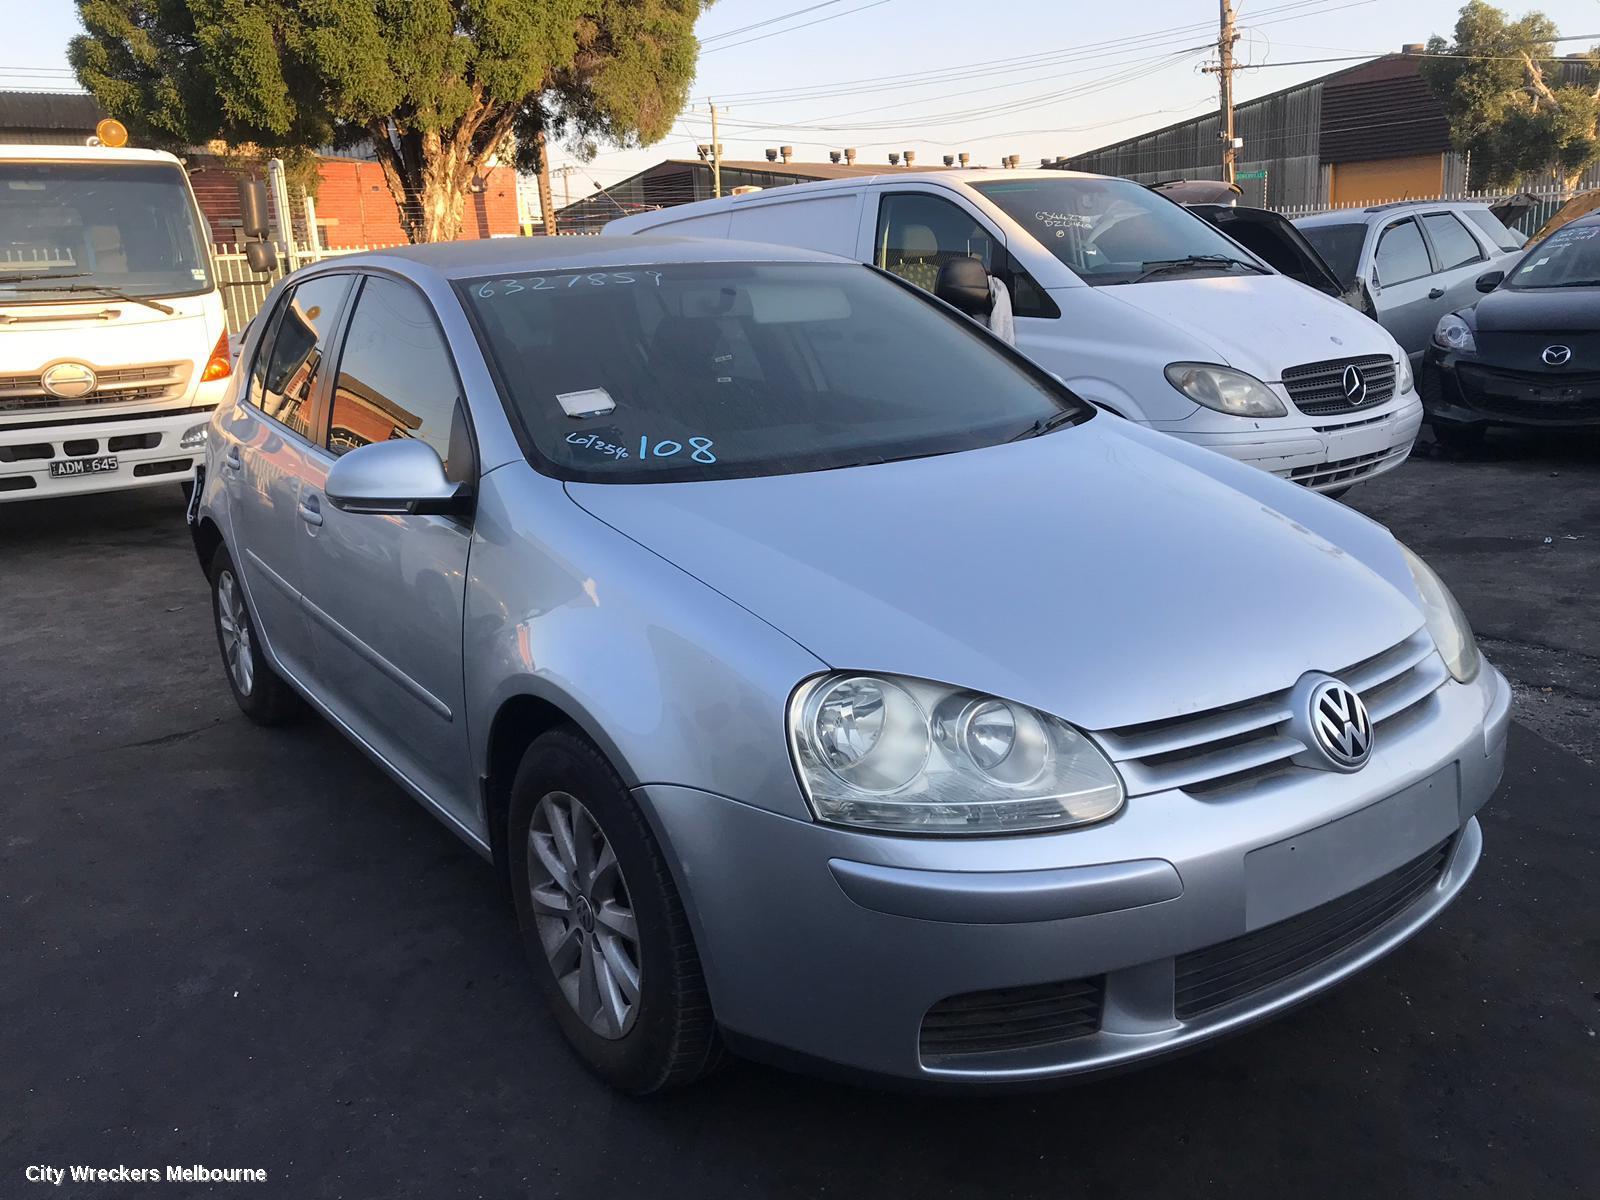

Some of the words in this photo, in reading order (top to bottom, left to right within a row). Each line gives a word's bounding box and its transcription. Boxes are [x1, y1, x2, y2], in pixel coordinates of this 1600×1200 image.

[639, 435, 717, 464] 108
[58, 461, 84, 475] ADM
[91, 457, 118, 471] 645
